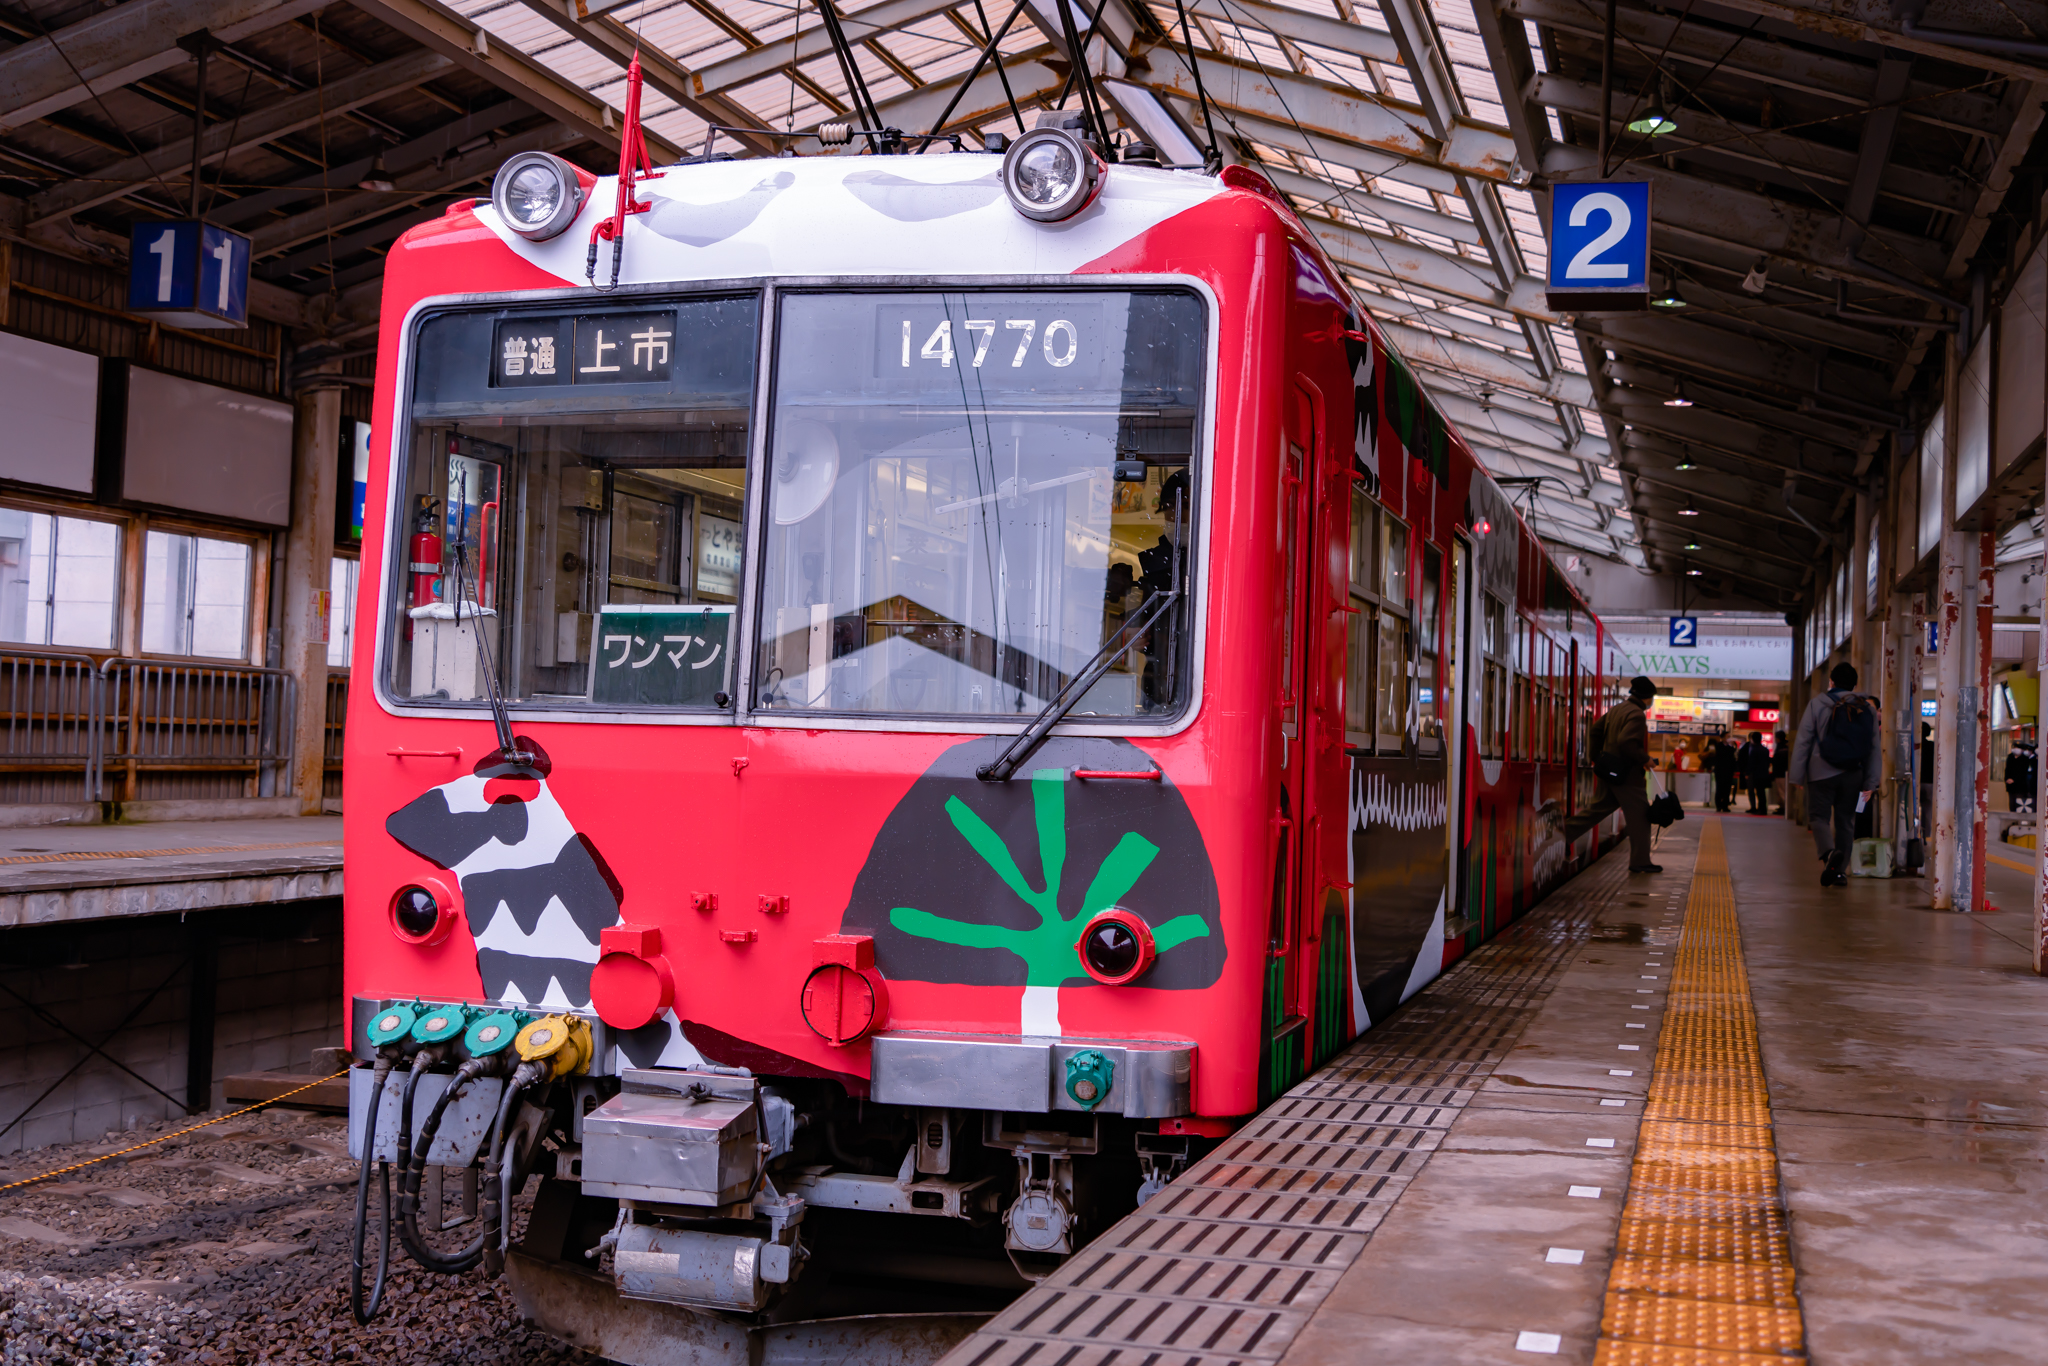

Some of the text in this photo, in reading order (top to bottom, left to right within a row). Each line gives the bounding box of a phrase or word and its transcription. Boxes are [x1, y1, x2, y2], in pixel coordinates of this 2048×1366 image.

[1565, 192, 1632, 279] 2
[148, 229, 175, 302] 1
[213, 237, 233, 311] 1
[503, 326, 672, 376] 普通 上市
[902, 319, 1078, 368] 14770
[603, 635, 722, 670] ワンマン
[1673, 619, 1693, 644] 2
[1758, 710, 1780, 722] LO
